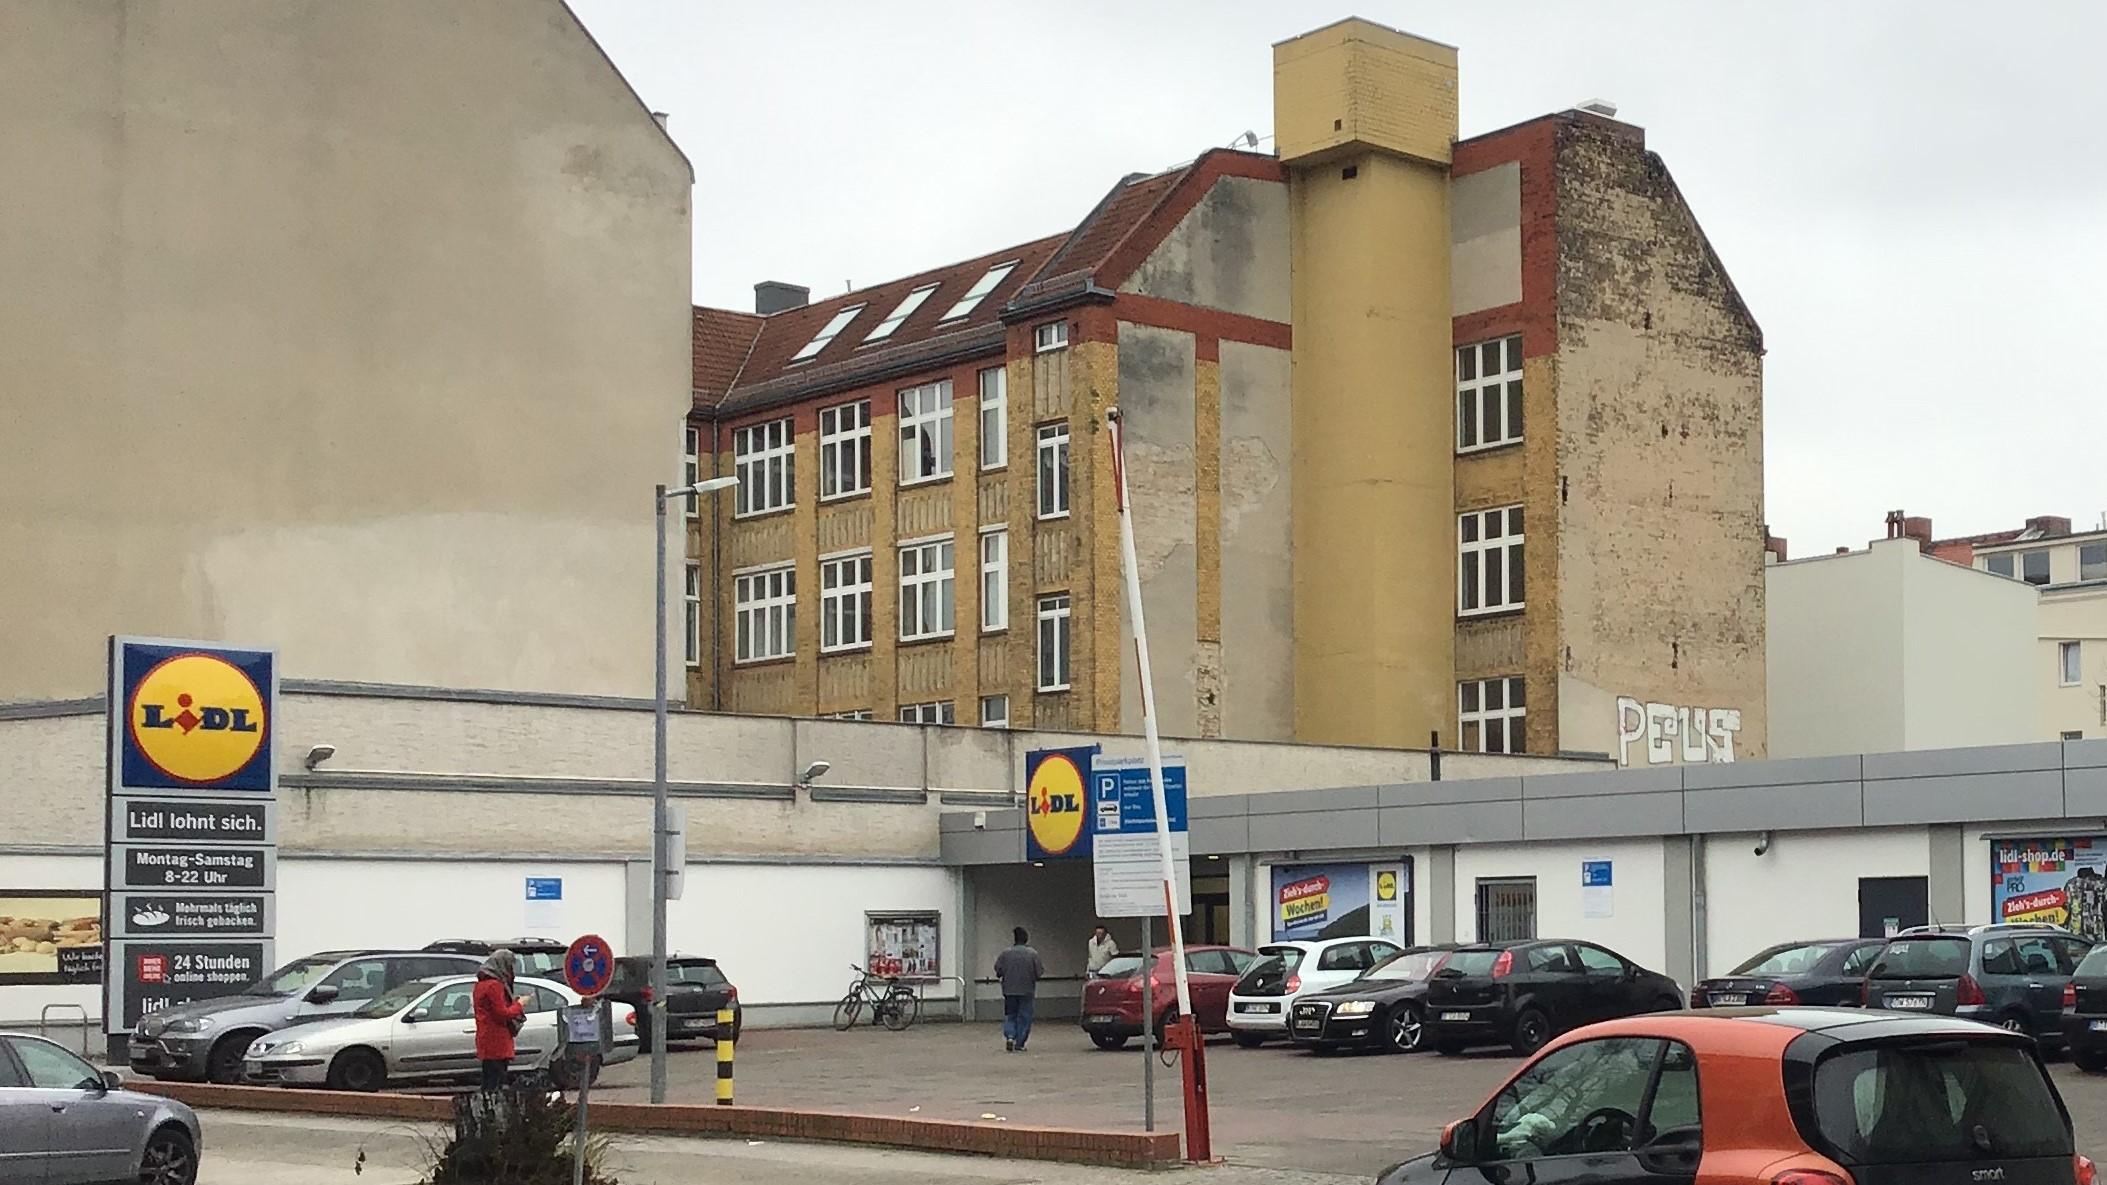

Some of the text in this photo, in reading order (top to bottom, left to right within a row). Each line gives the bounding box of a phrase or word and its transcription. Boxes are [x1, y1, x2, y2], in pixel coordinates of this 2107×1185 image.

[1101, 777, 1115, 799] P
[130, 811, 262, 831] Lidl lohnt sich.
[136, 852, 254, 868] Montag-Samstag
[2000, 848, 2066, 865] lidl-shop.de
[165, 870, 228, 883] 8-22 Uhr
[1286, 896, 1323, 917] Wochen!
[174, 954, 191, 970] 24
[195, 954, 250, 969] Stunden
[173, 972, 205, 982] online
